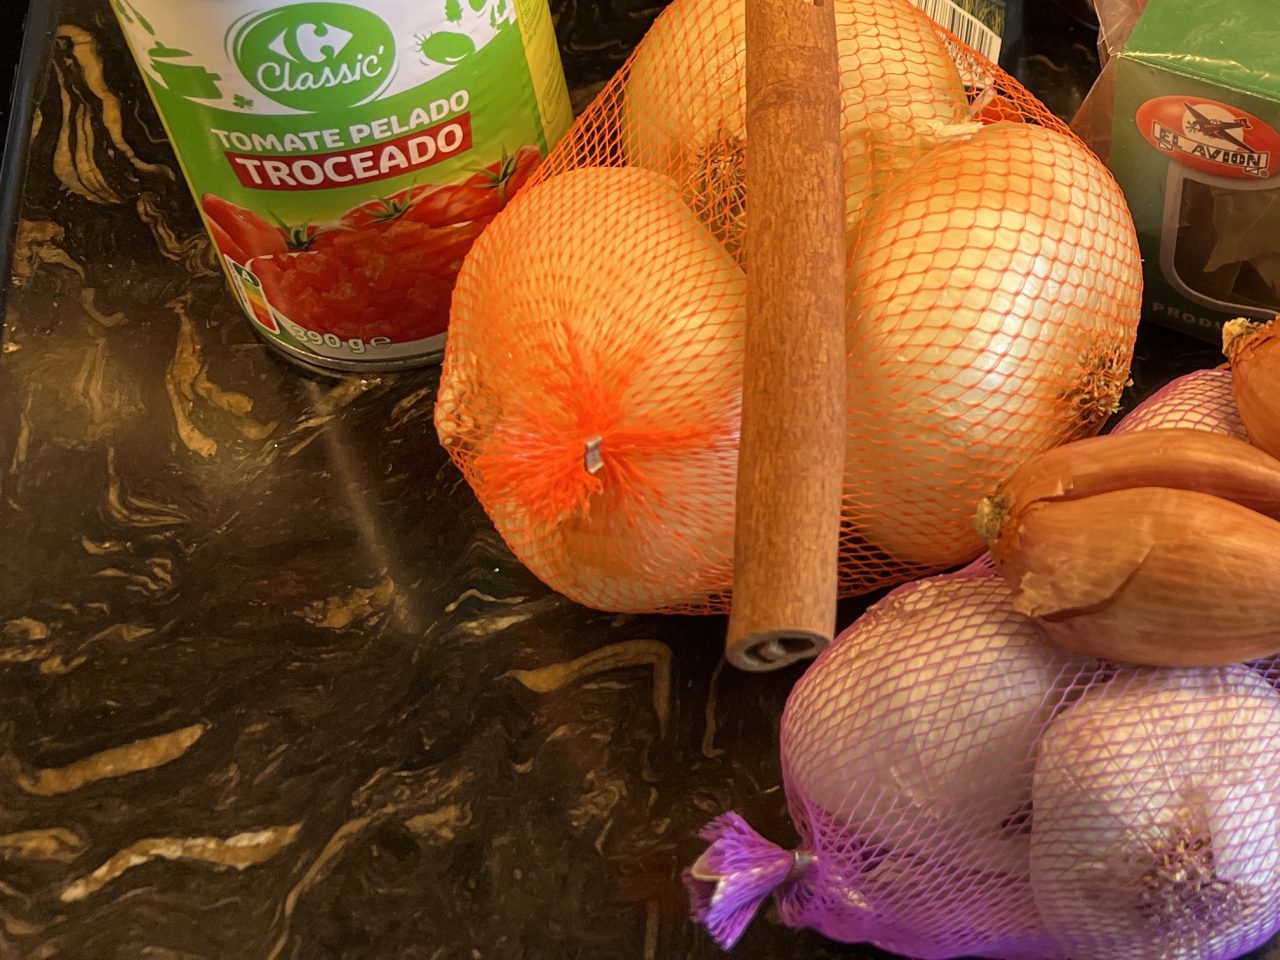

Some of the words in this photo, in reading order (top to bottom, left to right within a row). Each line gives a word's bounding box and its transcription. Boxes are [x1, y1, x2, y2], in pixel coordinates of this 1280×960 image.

[211, 127, 343, 154] TOMATE
[351, 90, 470, 143] PELADO
[1160, 127, 1184, 149] EL
[1192, 143, 1262, 168] AVION
[237, 123, 464, 187] TROCEADO
[291, 326, 342, 348] 390
[348, 338, 366, 354] g
